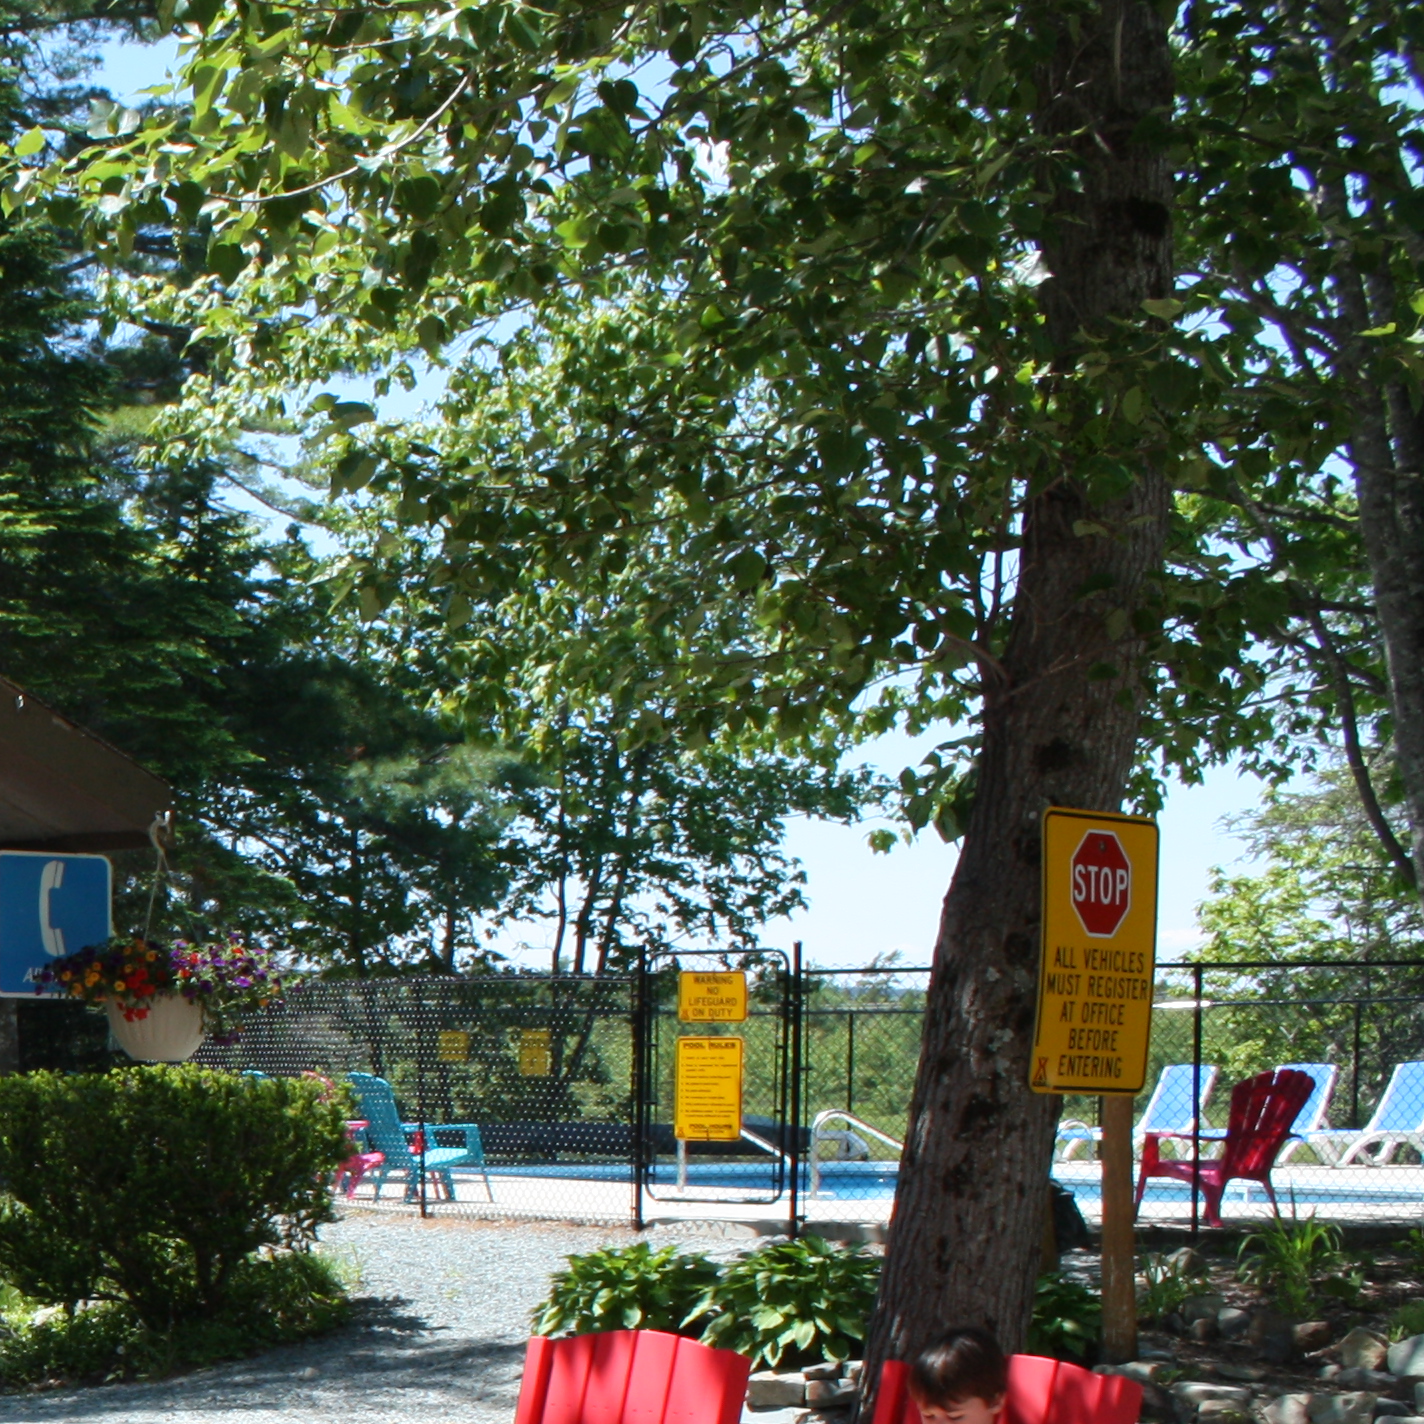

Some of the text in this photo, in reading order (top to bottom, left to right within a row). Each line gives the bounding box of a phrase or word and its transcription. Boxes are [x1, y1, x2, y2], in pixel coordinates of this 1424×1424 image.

[1073, 864, 1129, 905] STOP
[1053, 946, 1145, 973] ALL VEHICLES
[693, 976, 733, 985] WARNING
[707, 987, 719, 995] NO
[1046, 973, 1149, 1000] MUST REGISTER
[688, 998, 737, 1007] LIFEGUARD
[692, 1009, 732, 1017] ON DUTY
[1060, 1001, 1125, 1025] AT OFFICE
[1068, 1028, 1119, 1051] BEFORE
[1058, 1055, 1122, 1078] ENTERING
